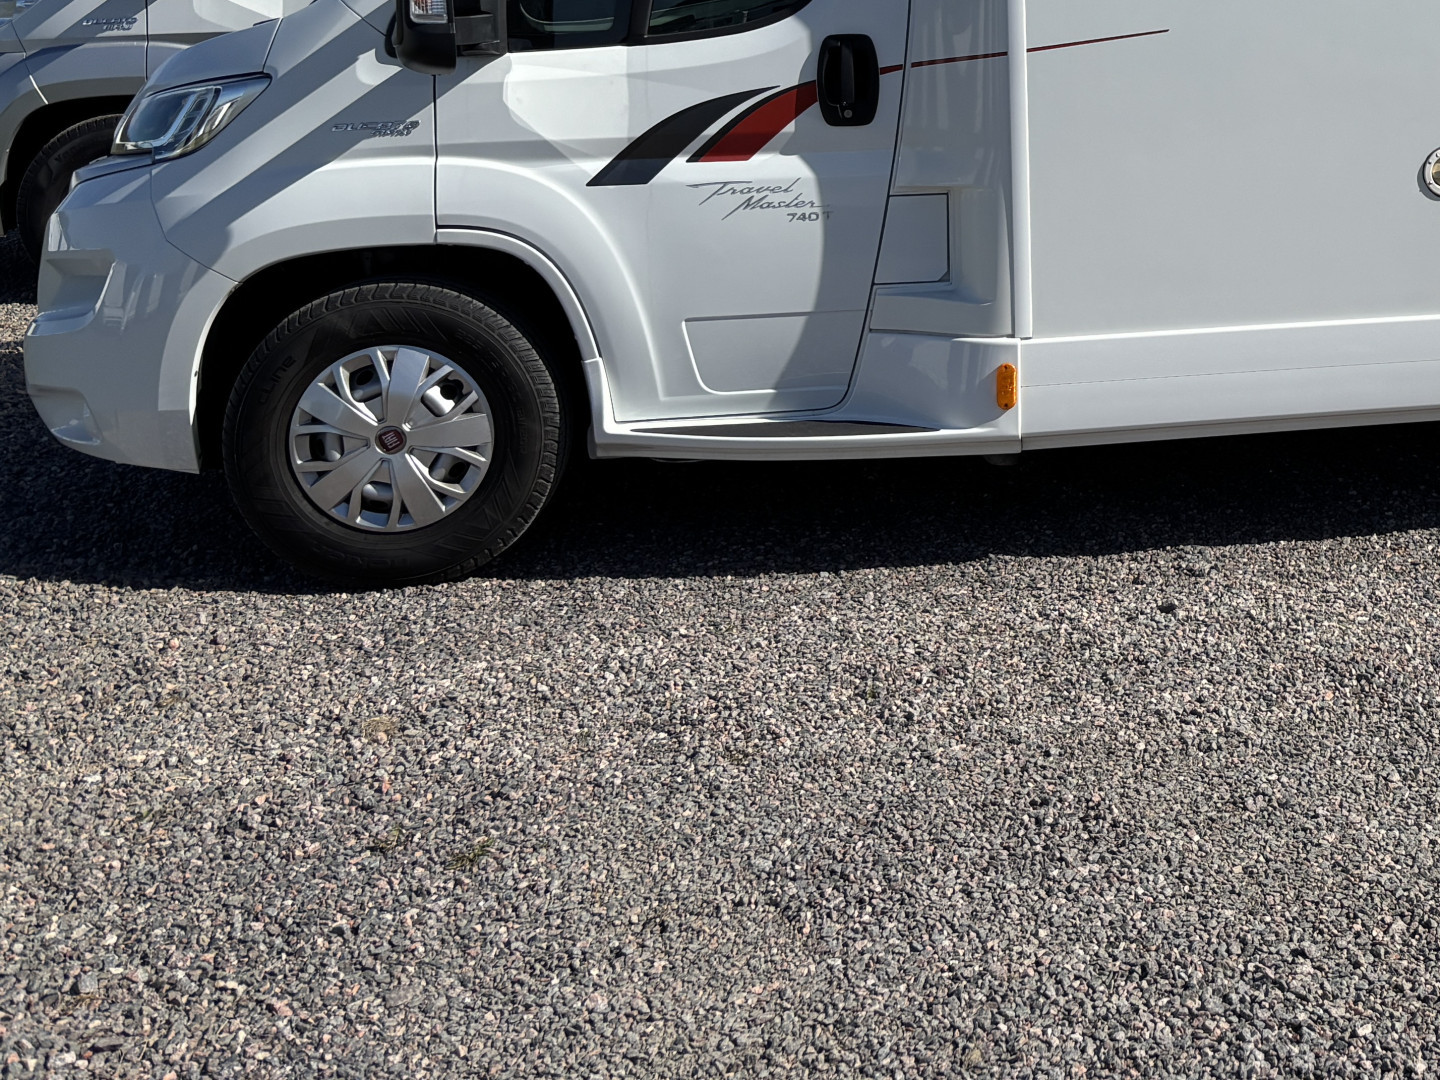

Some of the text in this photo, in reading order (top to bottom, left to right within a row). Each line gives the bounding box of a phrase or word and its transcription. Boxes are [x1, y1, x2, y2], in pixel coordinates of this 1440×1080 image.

[686, 177, 801, 205] Travel
[721, 193, 830, 220] Master
[787, 212, 819, 222] 740
